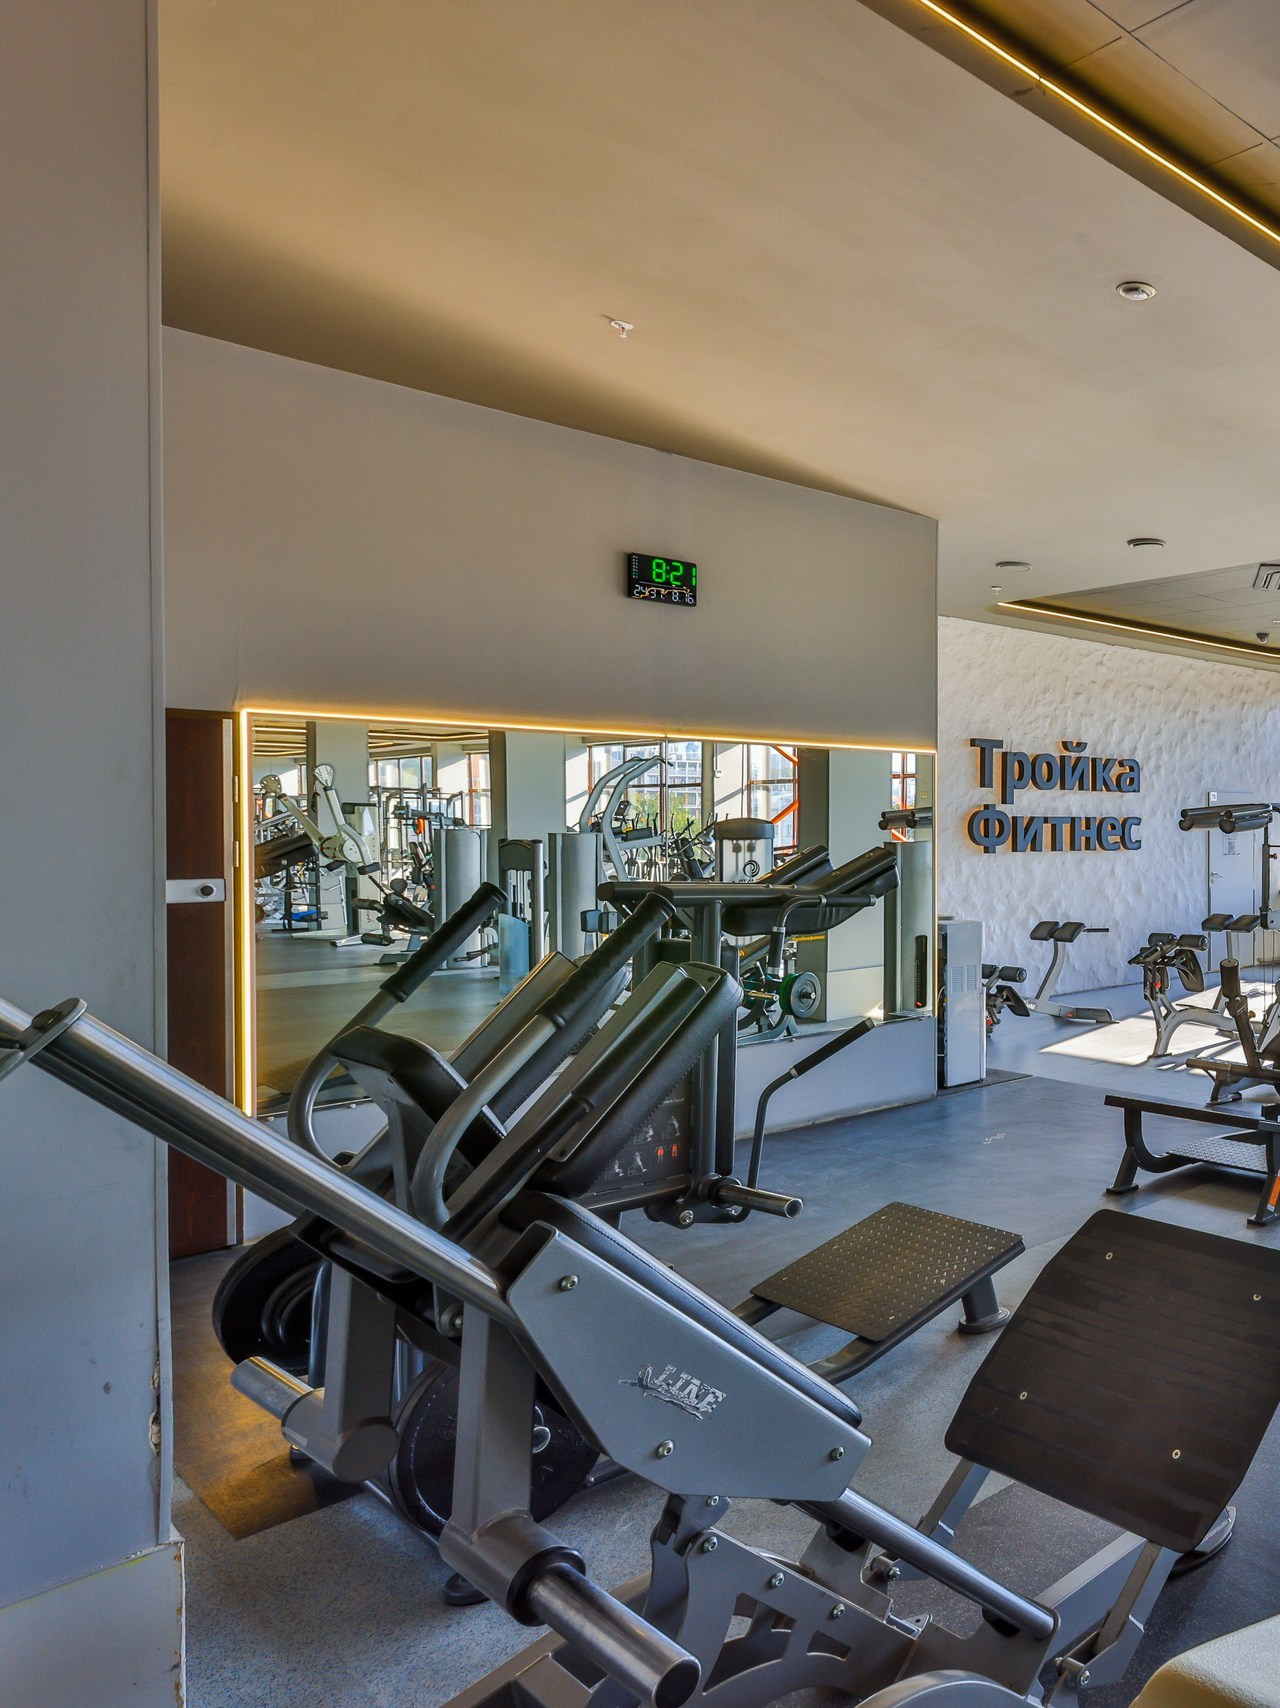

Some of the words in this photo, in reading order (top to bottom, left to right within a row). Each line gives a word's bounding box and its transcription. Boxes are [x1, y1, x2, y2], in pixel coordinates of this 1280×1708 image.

[652, 558, 697, 586] 8:21
[970, 738, 1141, 805] Тройка
[967, 804, 1142, 854] Фитнес
